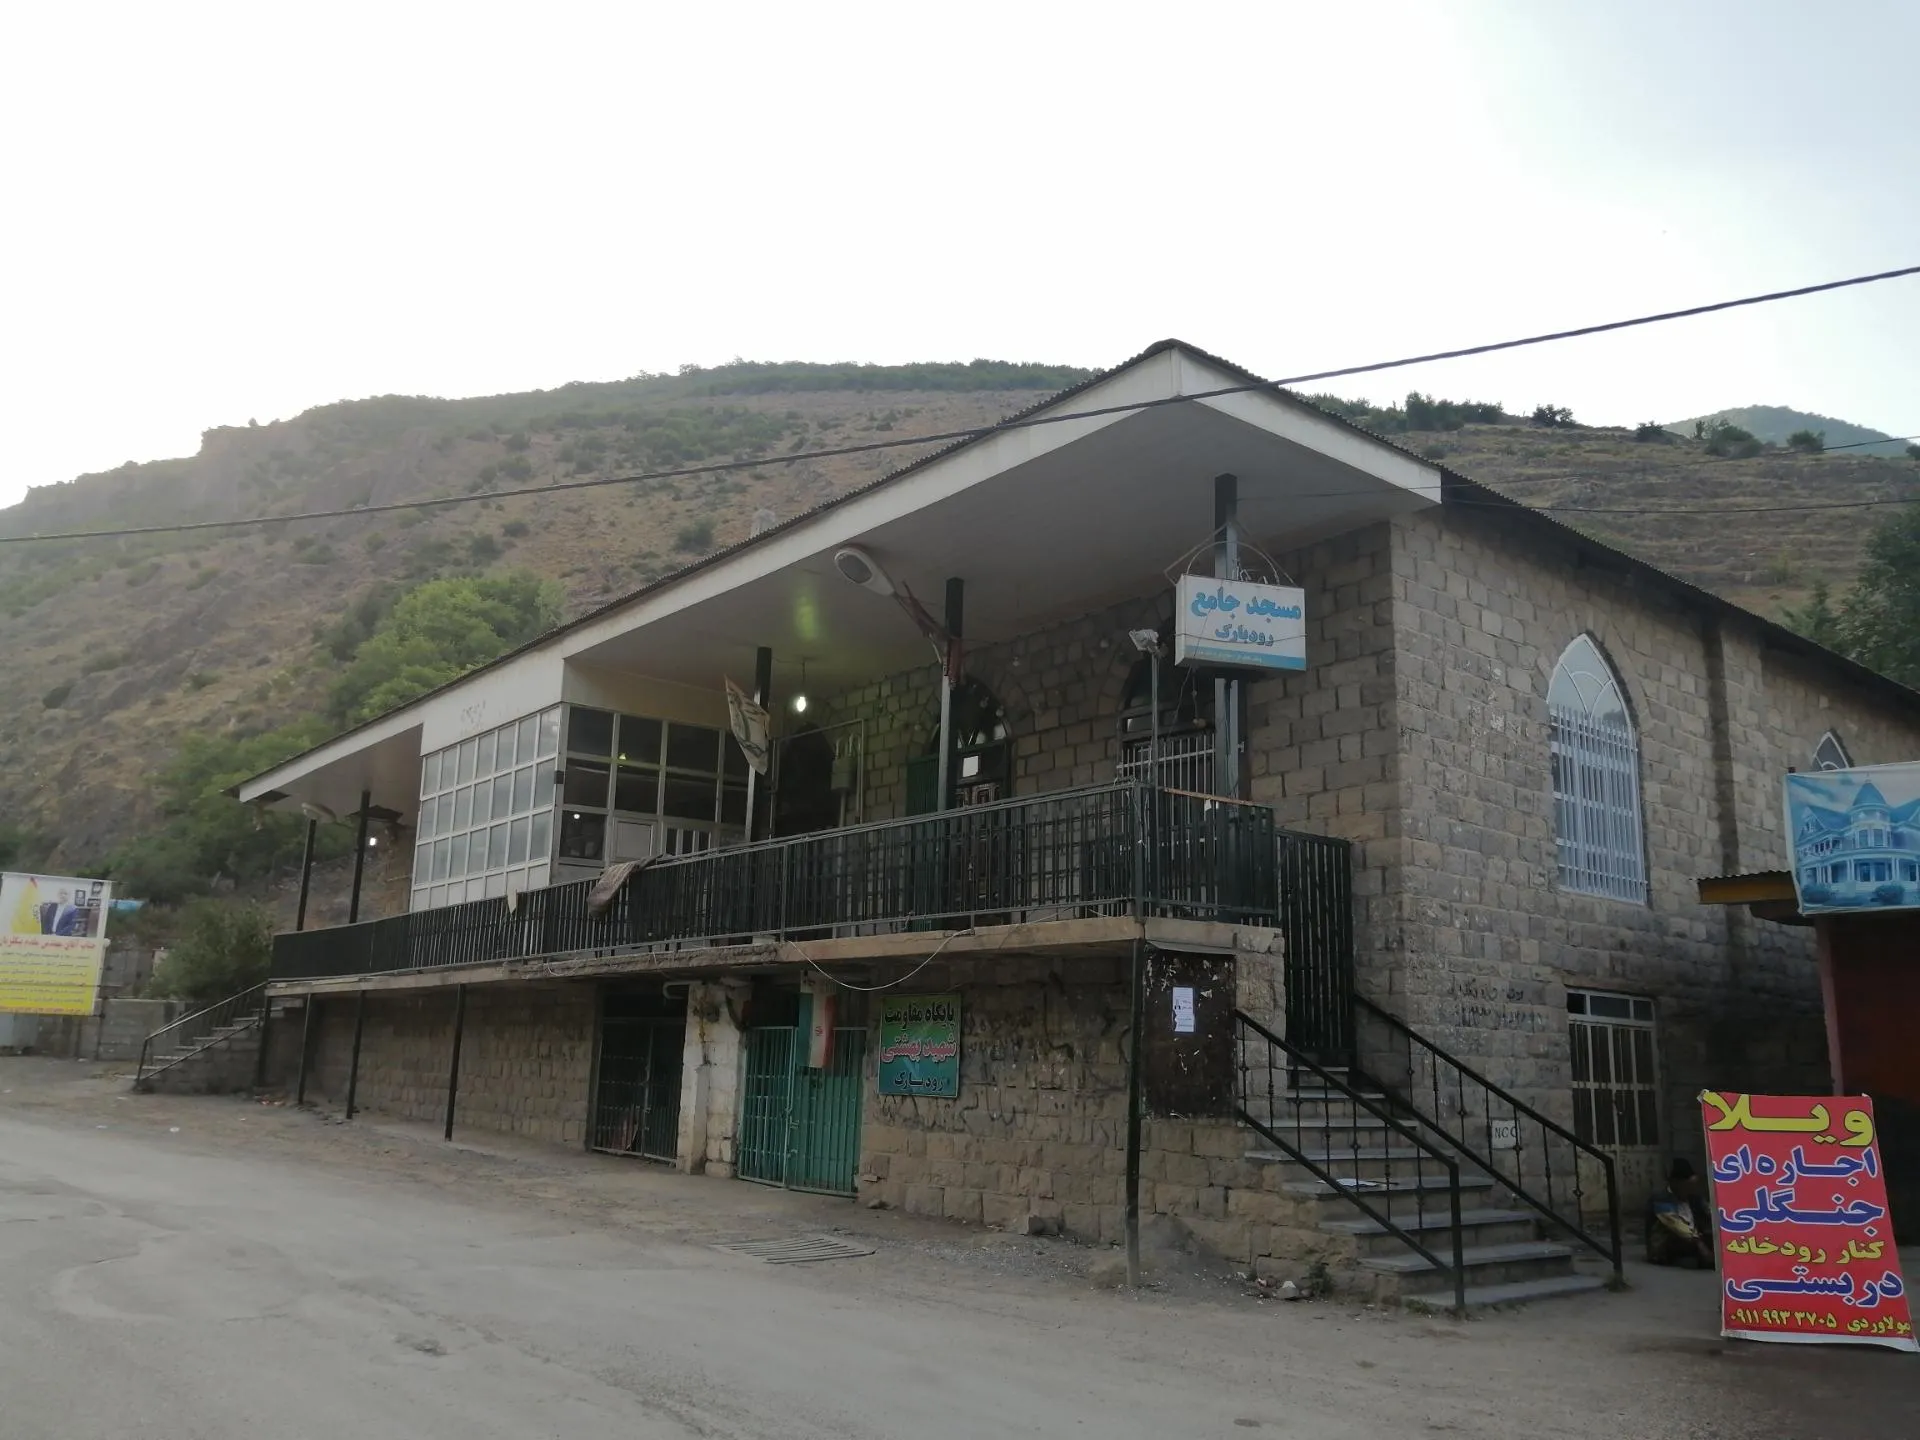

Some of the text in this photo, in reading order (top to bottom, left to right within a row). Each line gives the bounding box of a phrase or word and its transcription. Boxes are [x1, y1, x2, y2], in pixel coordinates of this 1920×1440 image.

[1191, 586, 1301, 624] مسجد جامع
[881, 1032, 957, 1063] شهید بهشتی
[1702, 1091, 1875, 1146] ویلا
[1718, 1186, 1885, 1237] جنگلی
[1726, 1236, 1885, 1264] کنار رودخانه
